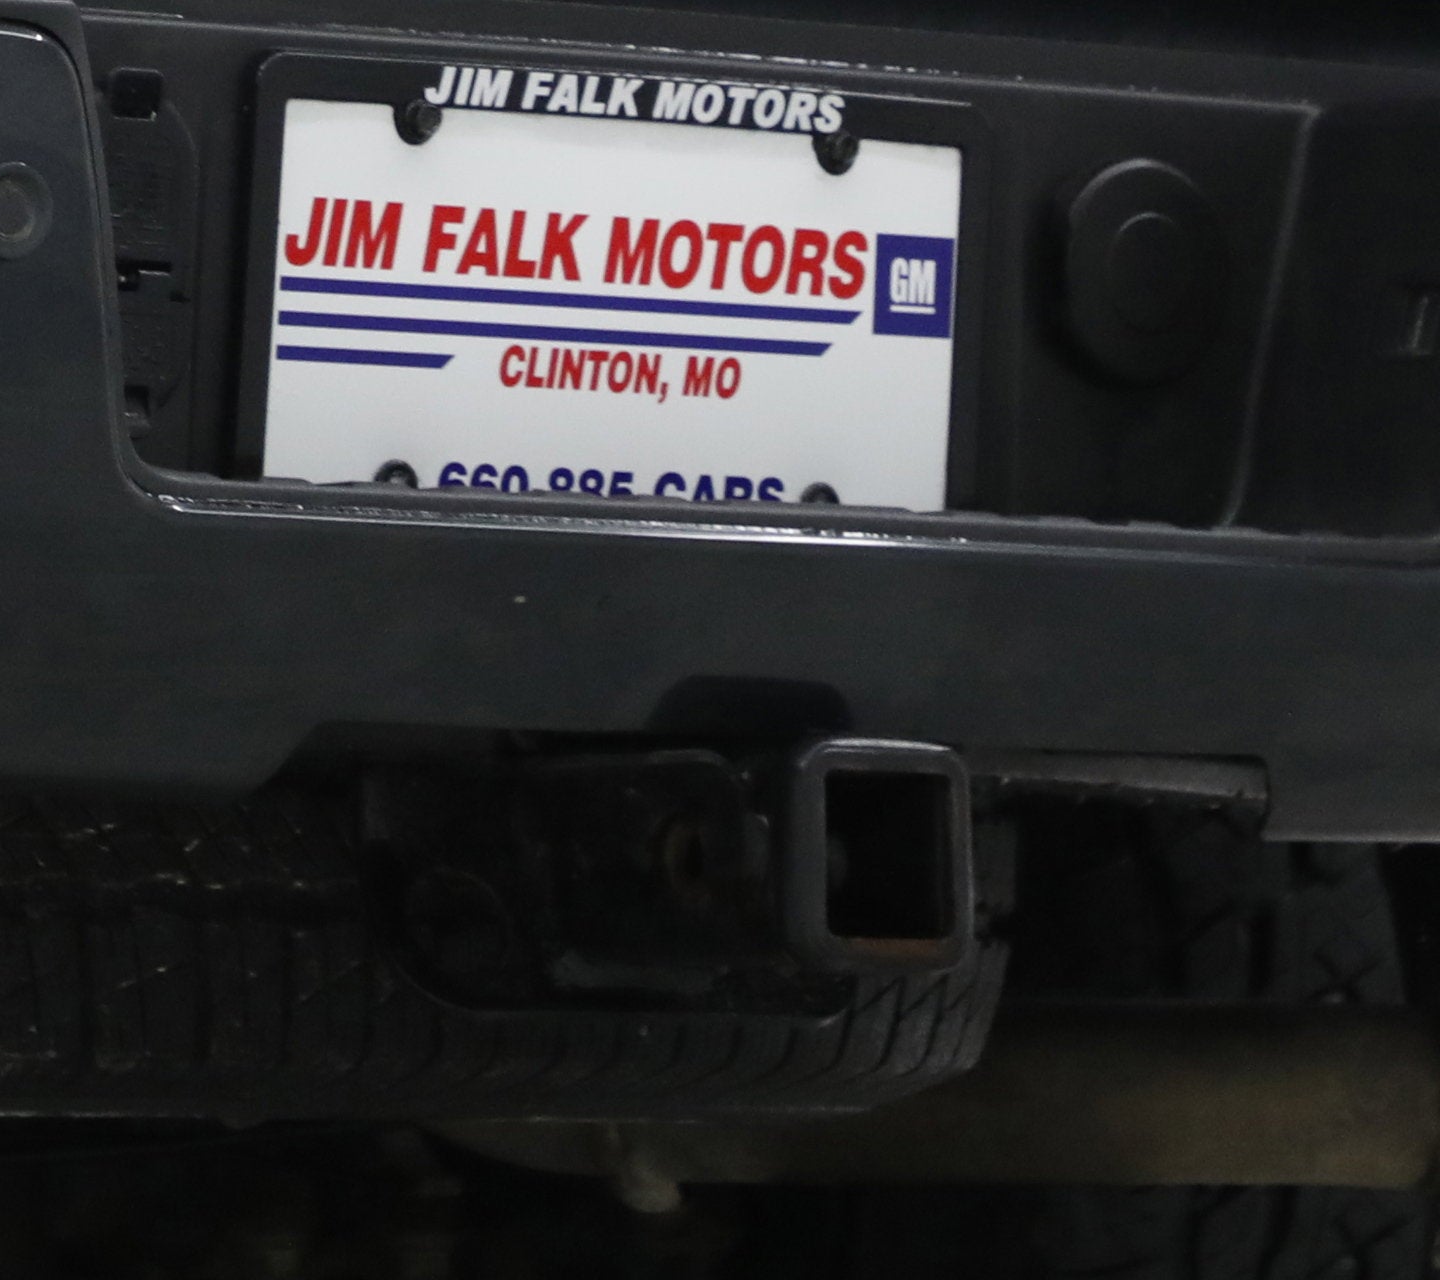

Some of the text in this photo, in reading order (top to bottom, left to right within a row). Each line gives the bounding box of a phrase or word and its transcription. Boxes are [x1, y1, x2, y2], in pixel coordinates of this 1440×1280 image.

[424, 65, 846, 134] JIM FALK MOTORS
[284, 196, 869, 300] JIM FALK MOTORS
[889, 256, 935, 306] GM
[499, 344, 742, 404] CLINTON, MO
